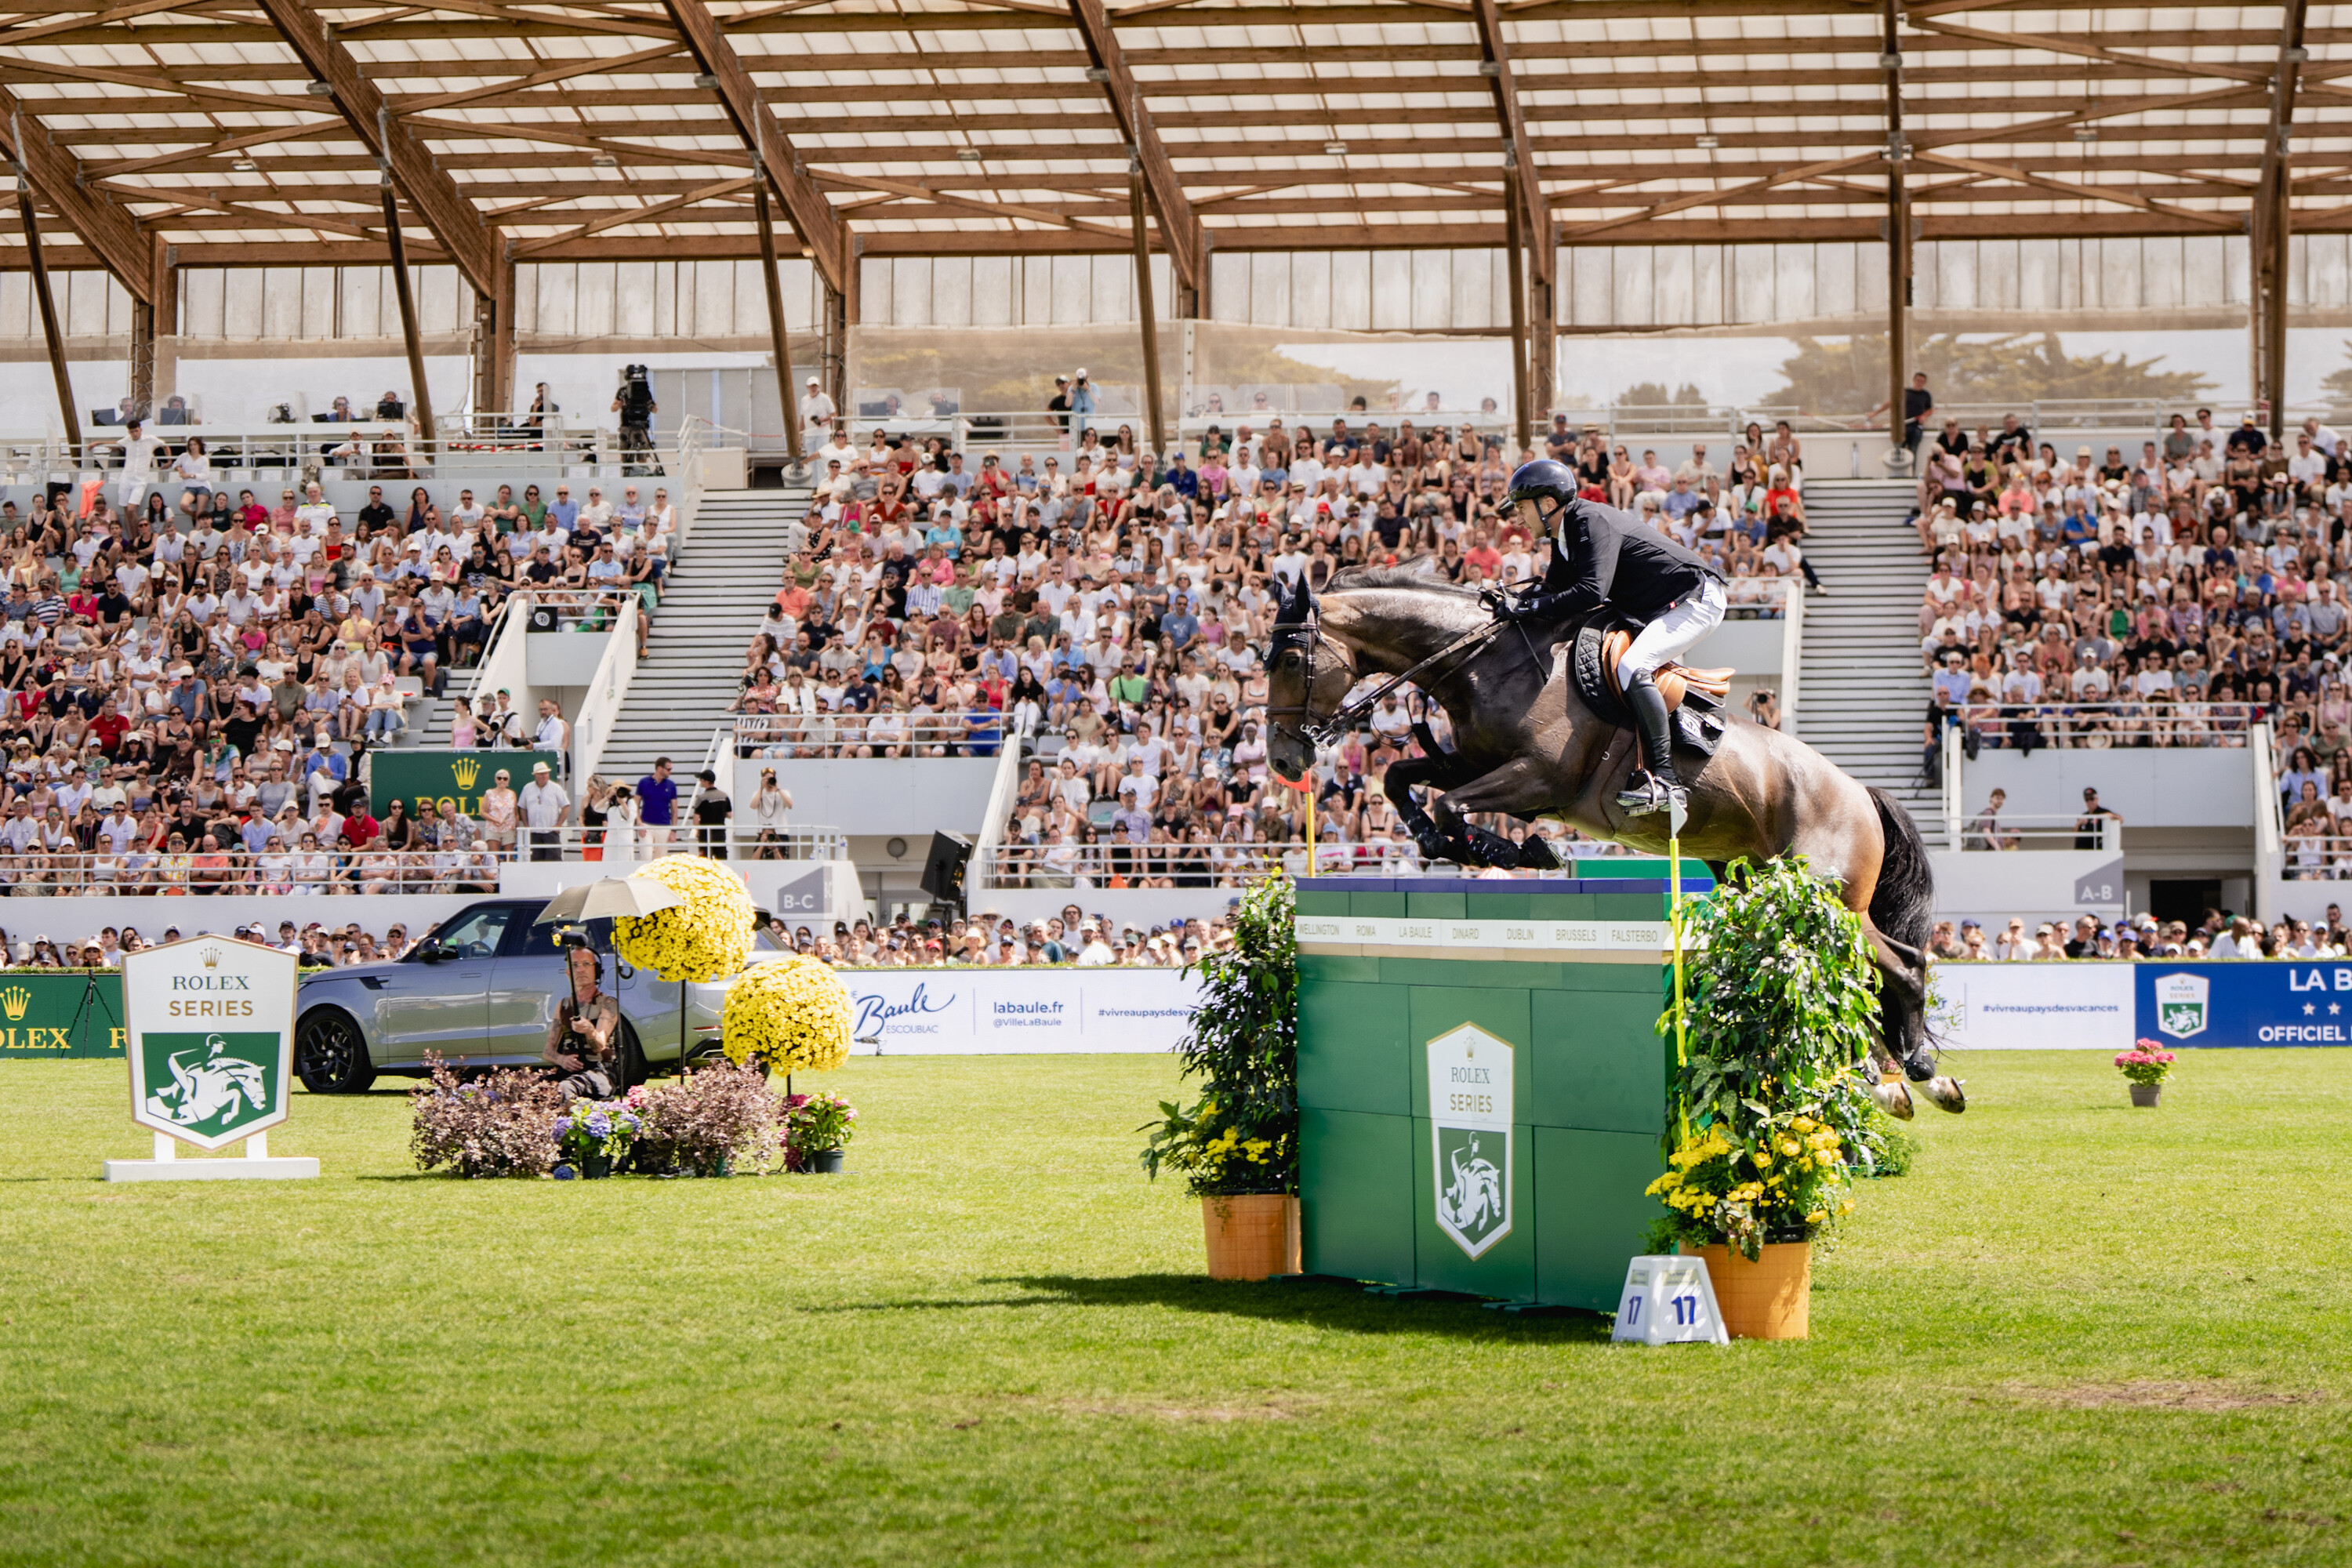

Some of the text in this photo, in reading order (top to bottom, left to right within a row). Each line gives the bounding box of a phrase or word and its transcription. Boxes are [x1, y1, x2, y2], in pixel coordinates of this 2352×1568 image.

[2081, 885, 2113, 900] A-B
[783, 894, 814, 909] B-C
[1298, 924, 1658, 942] WELLINGTON ROMA LA BAULE DINARD DUBLIN BRUSSELS FALSTERBO
[172, 975, 250, 990] ROLEX
[2289, 968, 2327, 992] LA
[169, 1000, 253, 1016] SERIES
[853, 982, 956, 1042] Baule
[993, 1001, 1064, 1014] labaule.fr
[1983, 1004, 2118, 1014] #vivreaupaysdesvacances
[886, 1025, 938, 1033] ESCOUBLAC
[993, 1018, 1062, 1028] @VilleLaBaule
[2258, 1025, 2347, 1042] OFFICIEL
[1450, 1067, 1490, 1084] ROLEX
[1450, 1093, 1492, 1113] SERIES
[1628, 1295, 1642, 1325] 17
[1670, 1296, 1696, 1325] 17
